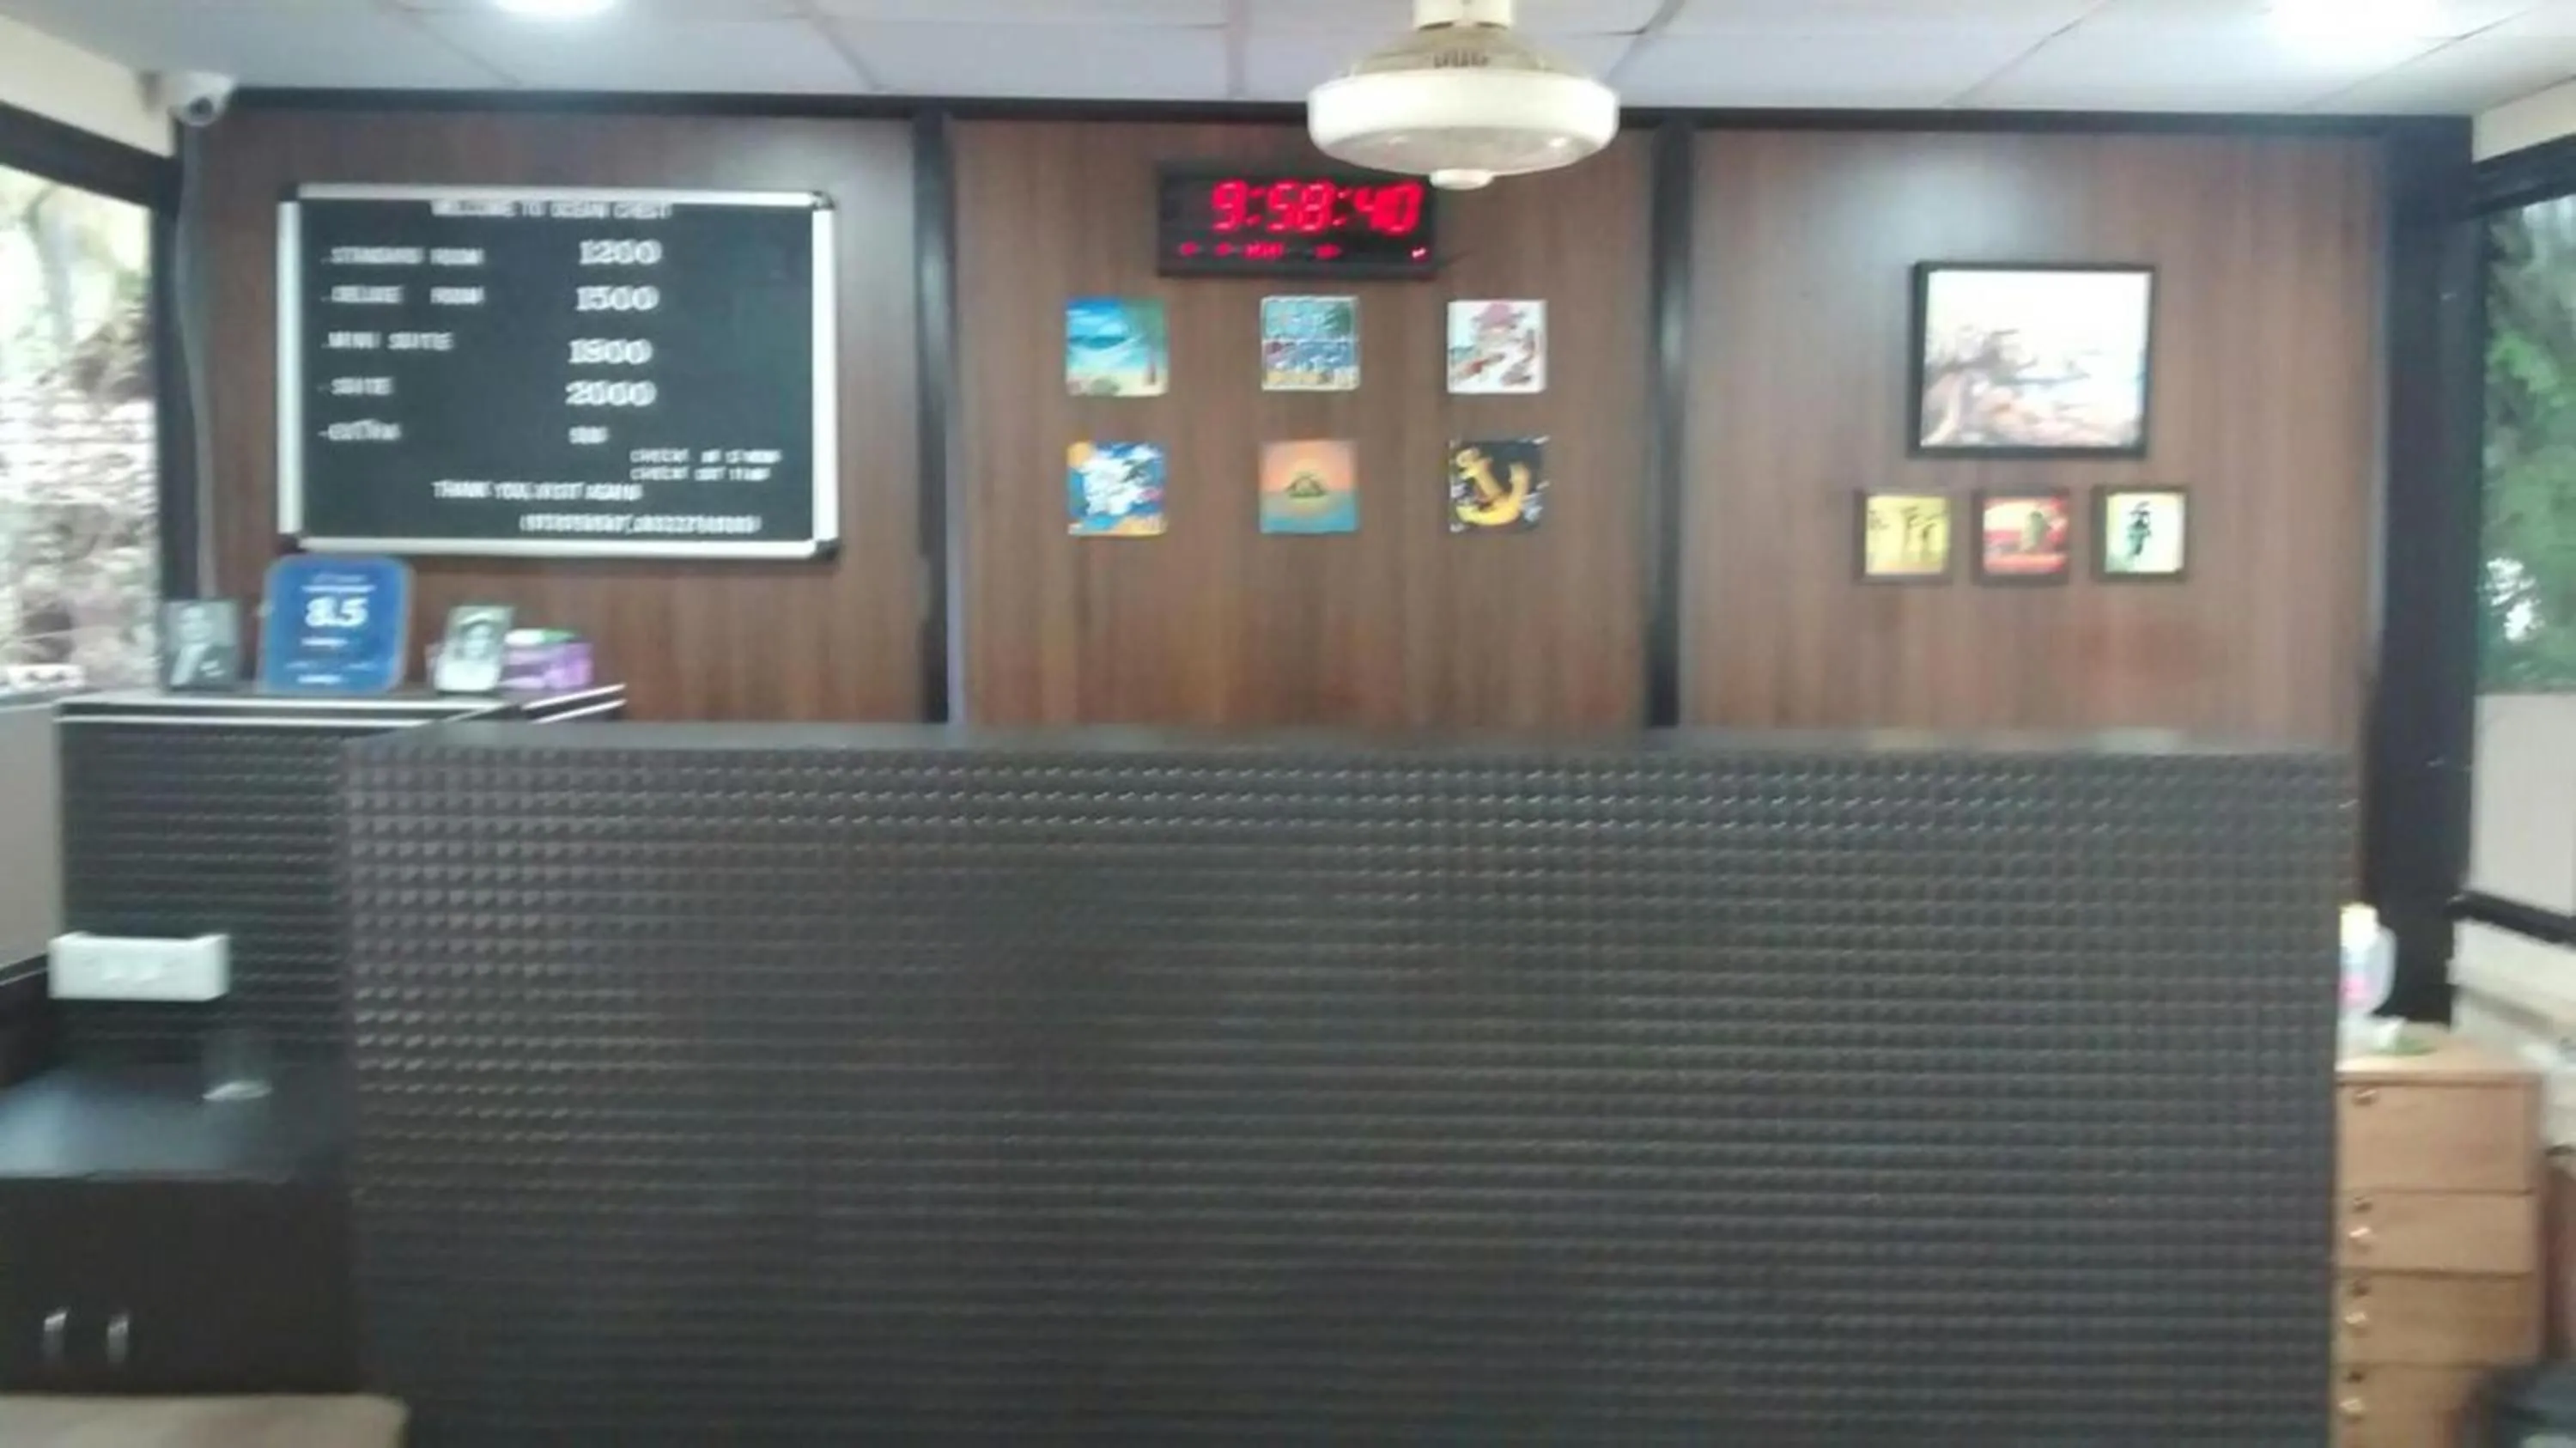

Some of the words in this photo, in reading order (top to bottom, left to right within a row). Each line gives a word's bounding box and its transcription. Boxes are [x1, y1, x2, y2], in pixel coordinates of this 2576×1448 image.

[1211, 179, 1425, 234] 9:58:40
[580, 239, 663, 265] 1200
[576, 285, 659, 310] 1500
[566, 380, 657, 406] 2000
